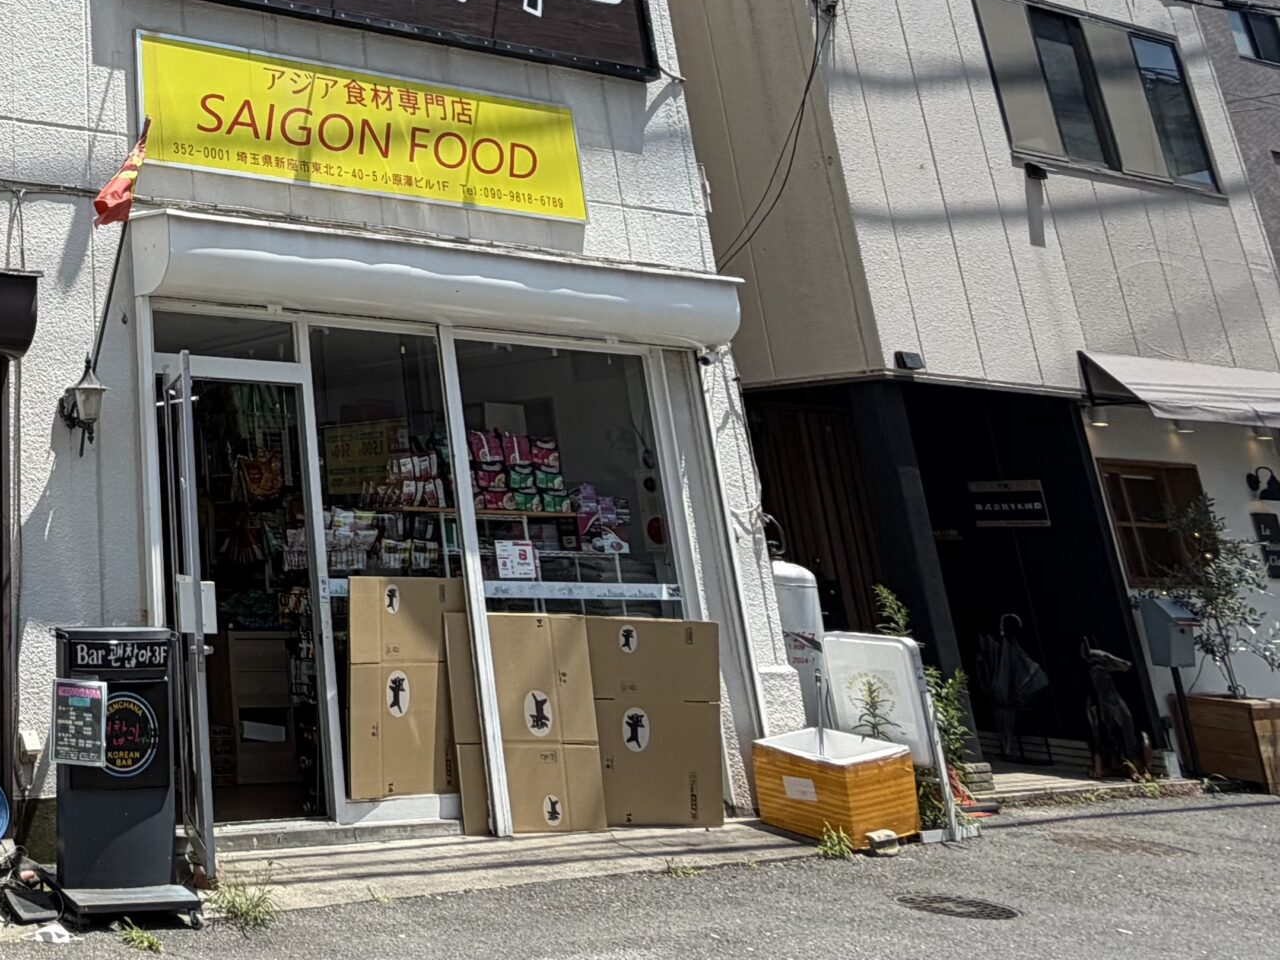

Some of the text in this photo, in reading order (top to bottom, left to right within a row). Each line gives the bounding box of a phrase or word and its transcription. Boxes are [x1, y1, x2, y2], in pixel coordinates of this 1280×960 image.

[263, 67, 473, 125] アジア食材専門店
[197, 94, 538, 179] SAIGON FOOD
[173, 142, 230, 161] 352-0001
[76, 644, 106, 665] Bar
[107, 701, 143, 717] ENCHANA
[107, 751, 140, 759] KOREAN
